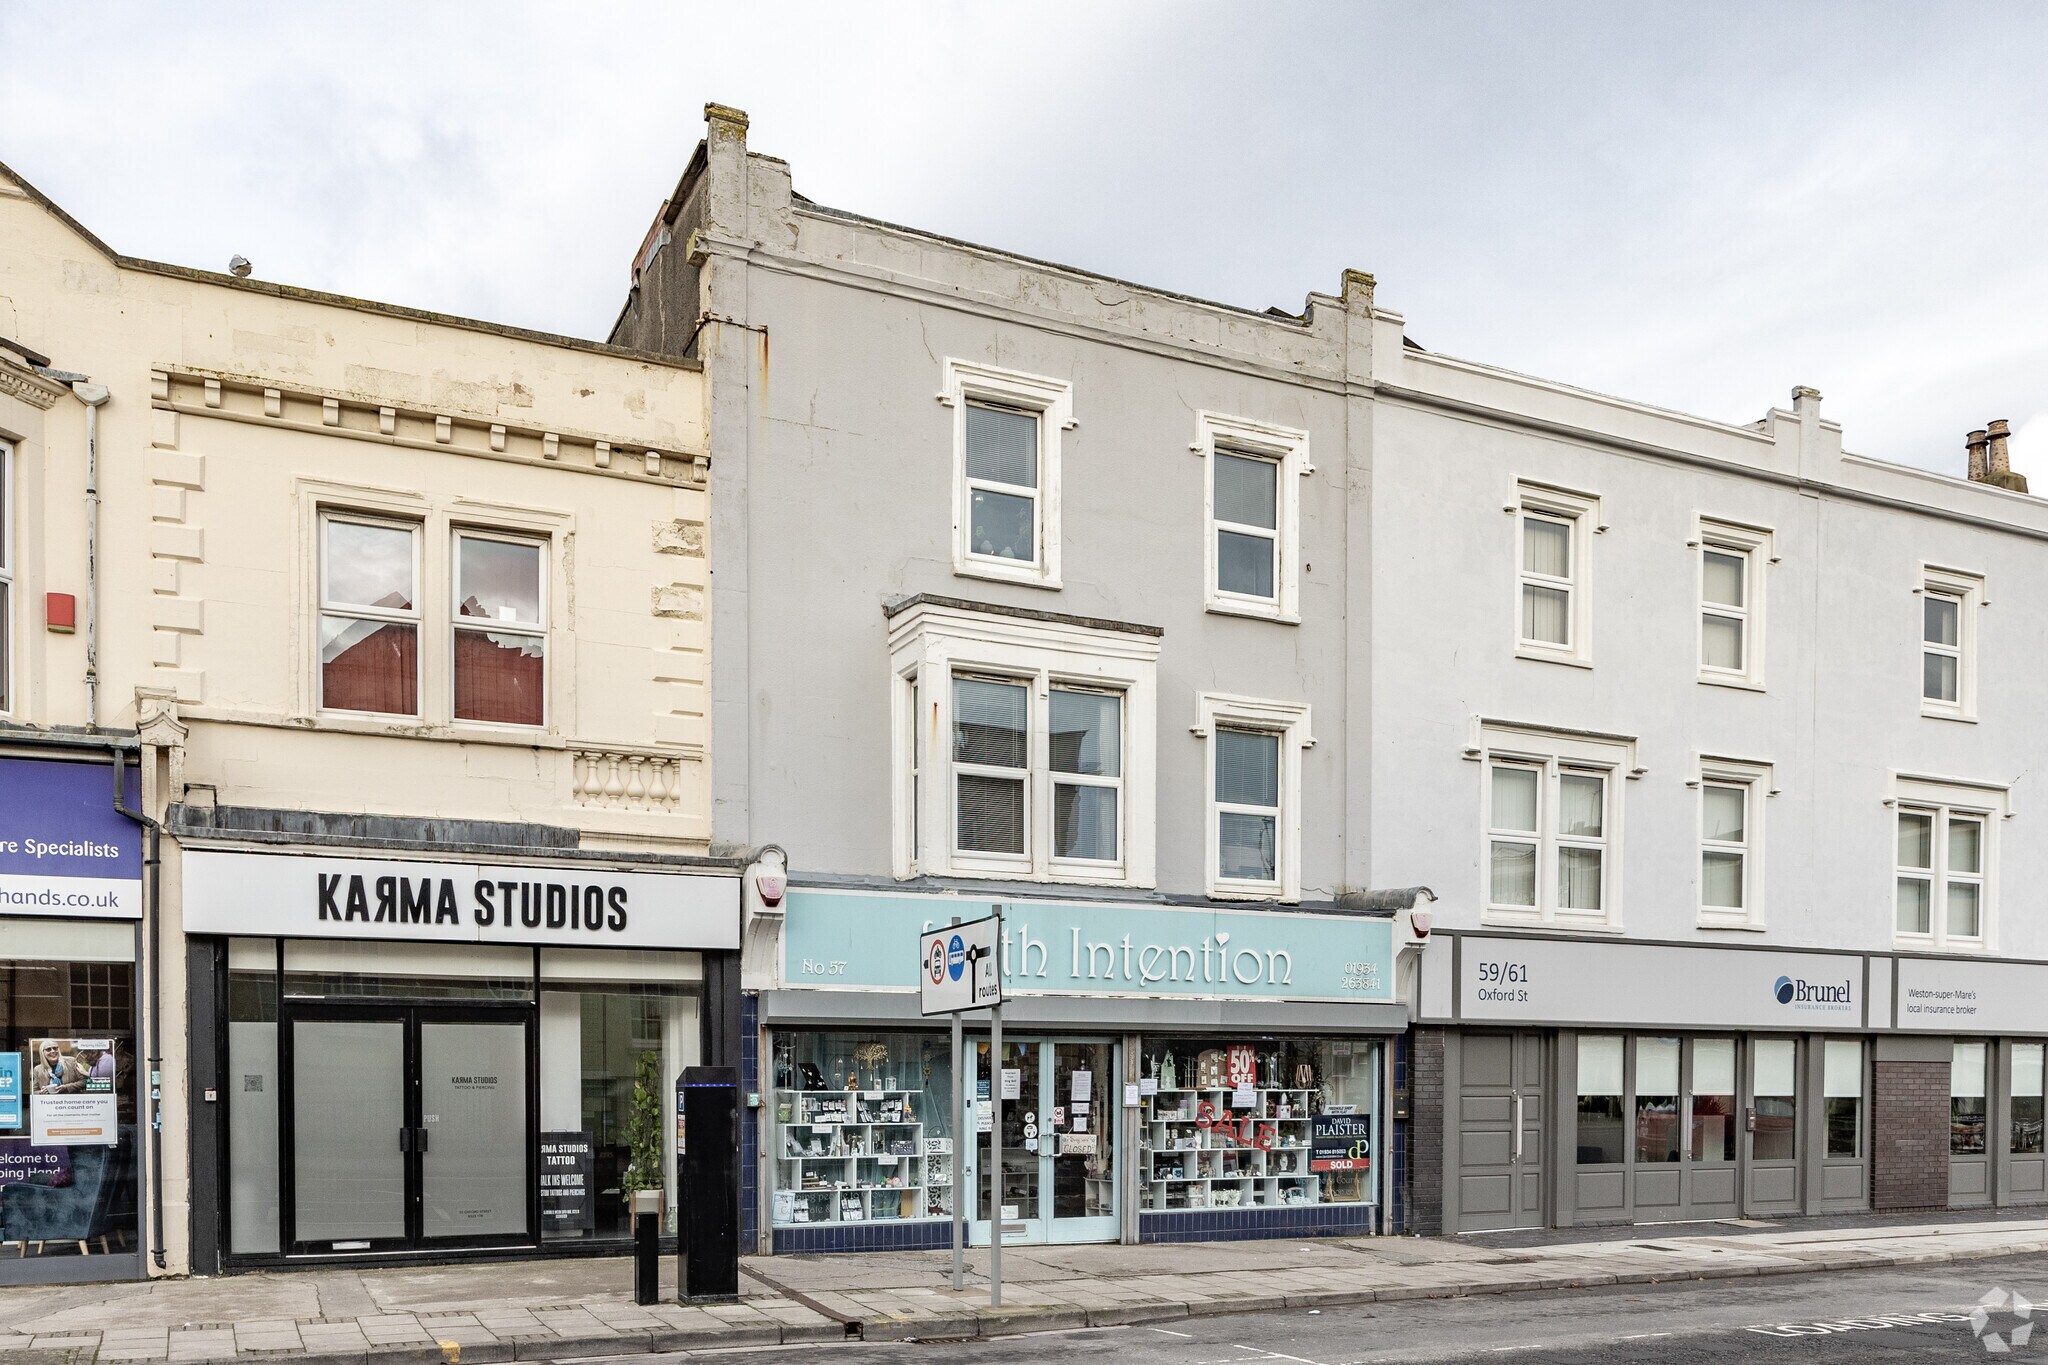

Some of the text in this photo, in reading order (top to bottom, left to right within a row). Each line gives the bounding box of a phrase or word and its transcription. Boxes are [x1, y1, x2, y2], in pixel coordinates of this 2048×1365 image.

[24, 838, 119, 859] Specialists
[474, 879, 628, 931] STUDIOS
[1070, 927, 1292, 987] Intention
[802, 958, 847, 975] No 57
[984, 962, 993, 977] All
[1478, 962, 1528, 985] 59/61
[978, 984, 998, 998] routes
[1478, 988, 1528, 1002] Oxford St
[1795, 979, 1851, 1003] Brunel
[1908, 988, 1977, 1000] Weston-super-Mare's
[1906, 1003, 1977, 1015] local insurance broker
[473, 1076, 498, 1084] STUDIOS
[1231, 1073, 1254, 1084] OFF
[1195, 1101, 1276, 1152] SALE
[1331, 1117, 1351, 1125] DAVID
[1315, 1124, 1366, 1136] PLAISTER
[558, 1144, 588, 1153] STUDIOS
[1063, 1144, 1092, 1153] CLOSED
[45, 1153, 58, 1163] to
[547, 1156, 576, 1165] TATTOO
[1330, 1160, 1353, 1169] SOLD
[561, 1173, 584, 1186] WELCOME
[1745, 1312, 1979, 1337] LOADING
